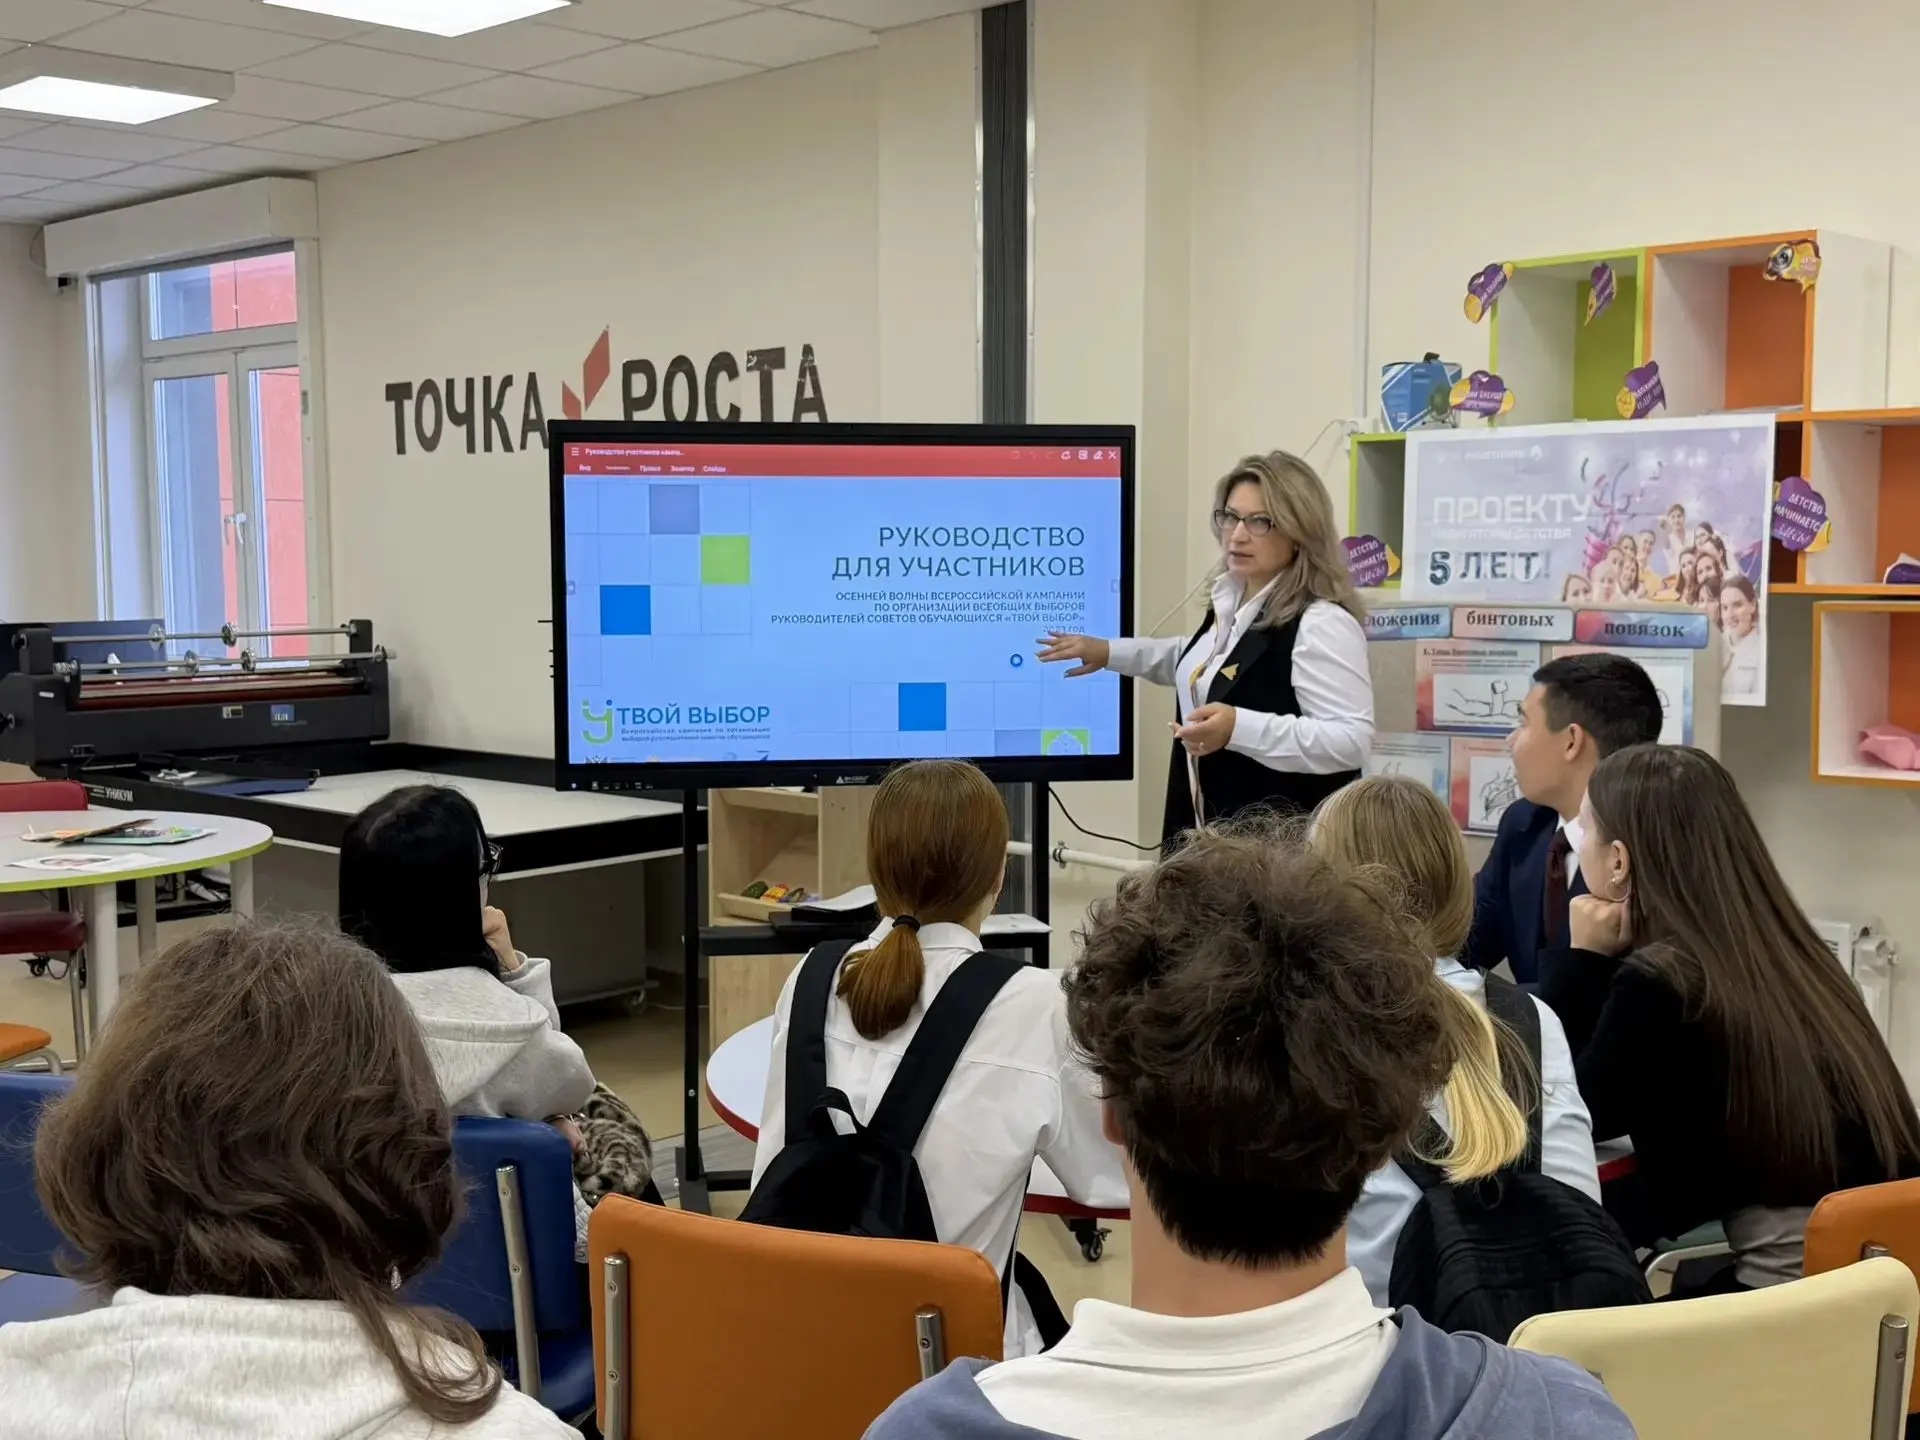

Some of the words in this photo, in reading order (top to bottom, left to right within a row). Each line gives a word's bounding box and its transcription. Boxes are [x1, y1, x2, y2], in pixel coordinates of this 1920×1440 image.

[385, 372, 549, 455] ТОЧКА
[622, 343, 829, 423] РОСТА
[1432, 493, 1593, 524] ПРОЕКТУ
[1788, 493, 1824, 515] ДЕТСТВО
[1774, 504, 1821, 532] НАЧИНАЕТС
[879, 526, 1085, 550] РУКОВОДСТВО
[832, 556, 890, 580] ДЛЯ
[898, 556, 1085, 577] УЧАСТНИКОВ
[1429, 550, 1451, 586] 5
[836, 590, 886, 601] ОСЕННЕЙ
[889, 591, 928, 601] ВОЛНЫ
[931, 590, 1023, 600] ВСЕРОССИЙСКОЙ
[1026, 591, 1085, 600] КАМПАНИИ
[874, 603, 890, 612] ПО
[892, 603, 970, 613] ОРГАНИЗАЦИИ
[973, 602, 1031, 612] ВСЕОБЩИХ
[1034, 602, 1085, 611] ВЫБОРОВ
[771, 613, 865, 624] РУКОВОДИТЕЛЕЙ
[867, 614, 916, 623] СОВЕТОВ
[918, 613, 1003, 623] ОБУЧАЮЩИХСЯ
[1005, 612, 1040, 622] «ТВОЙ
[1364, 611, 1441, 627] ложения
[1466, 610, 1554, 627] бинтовых
[1604, 621, 1685, 638] повязок
[616, 702, 680, 725] ТВОЙ
[688, 706, 770, 724] ВЫБОР
